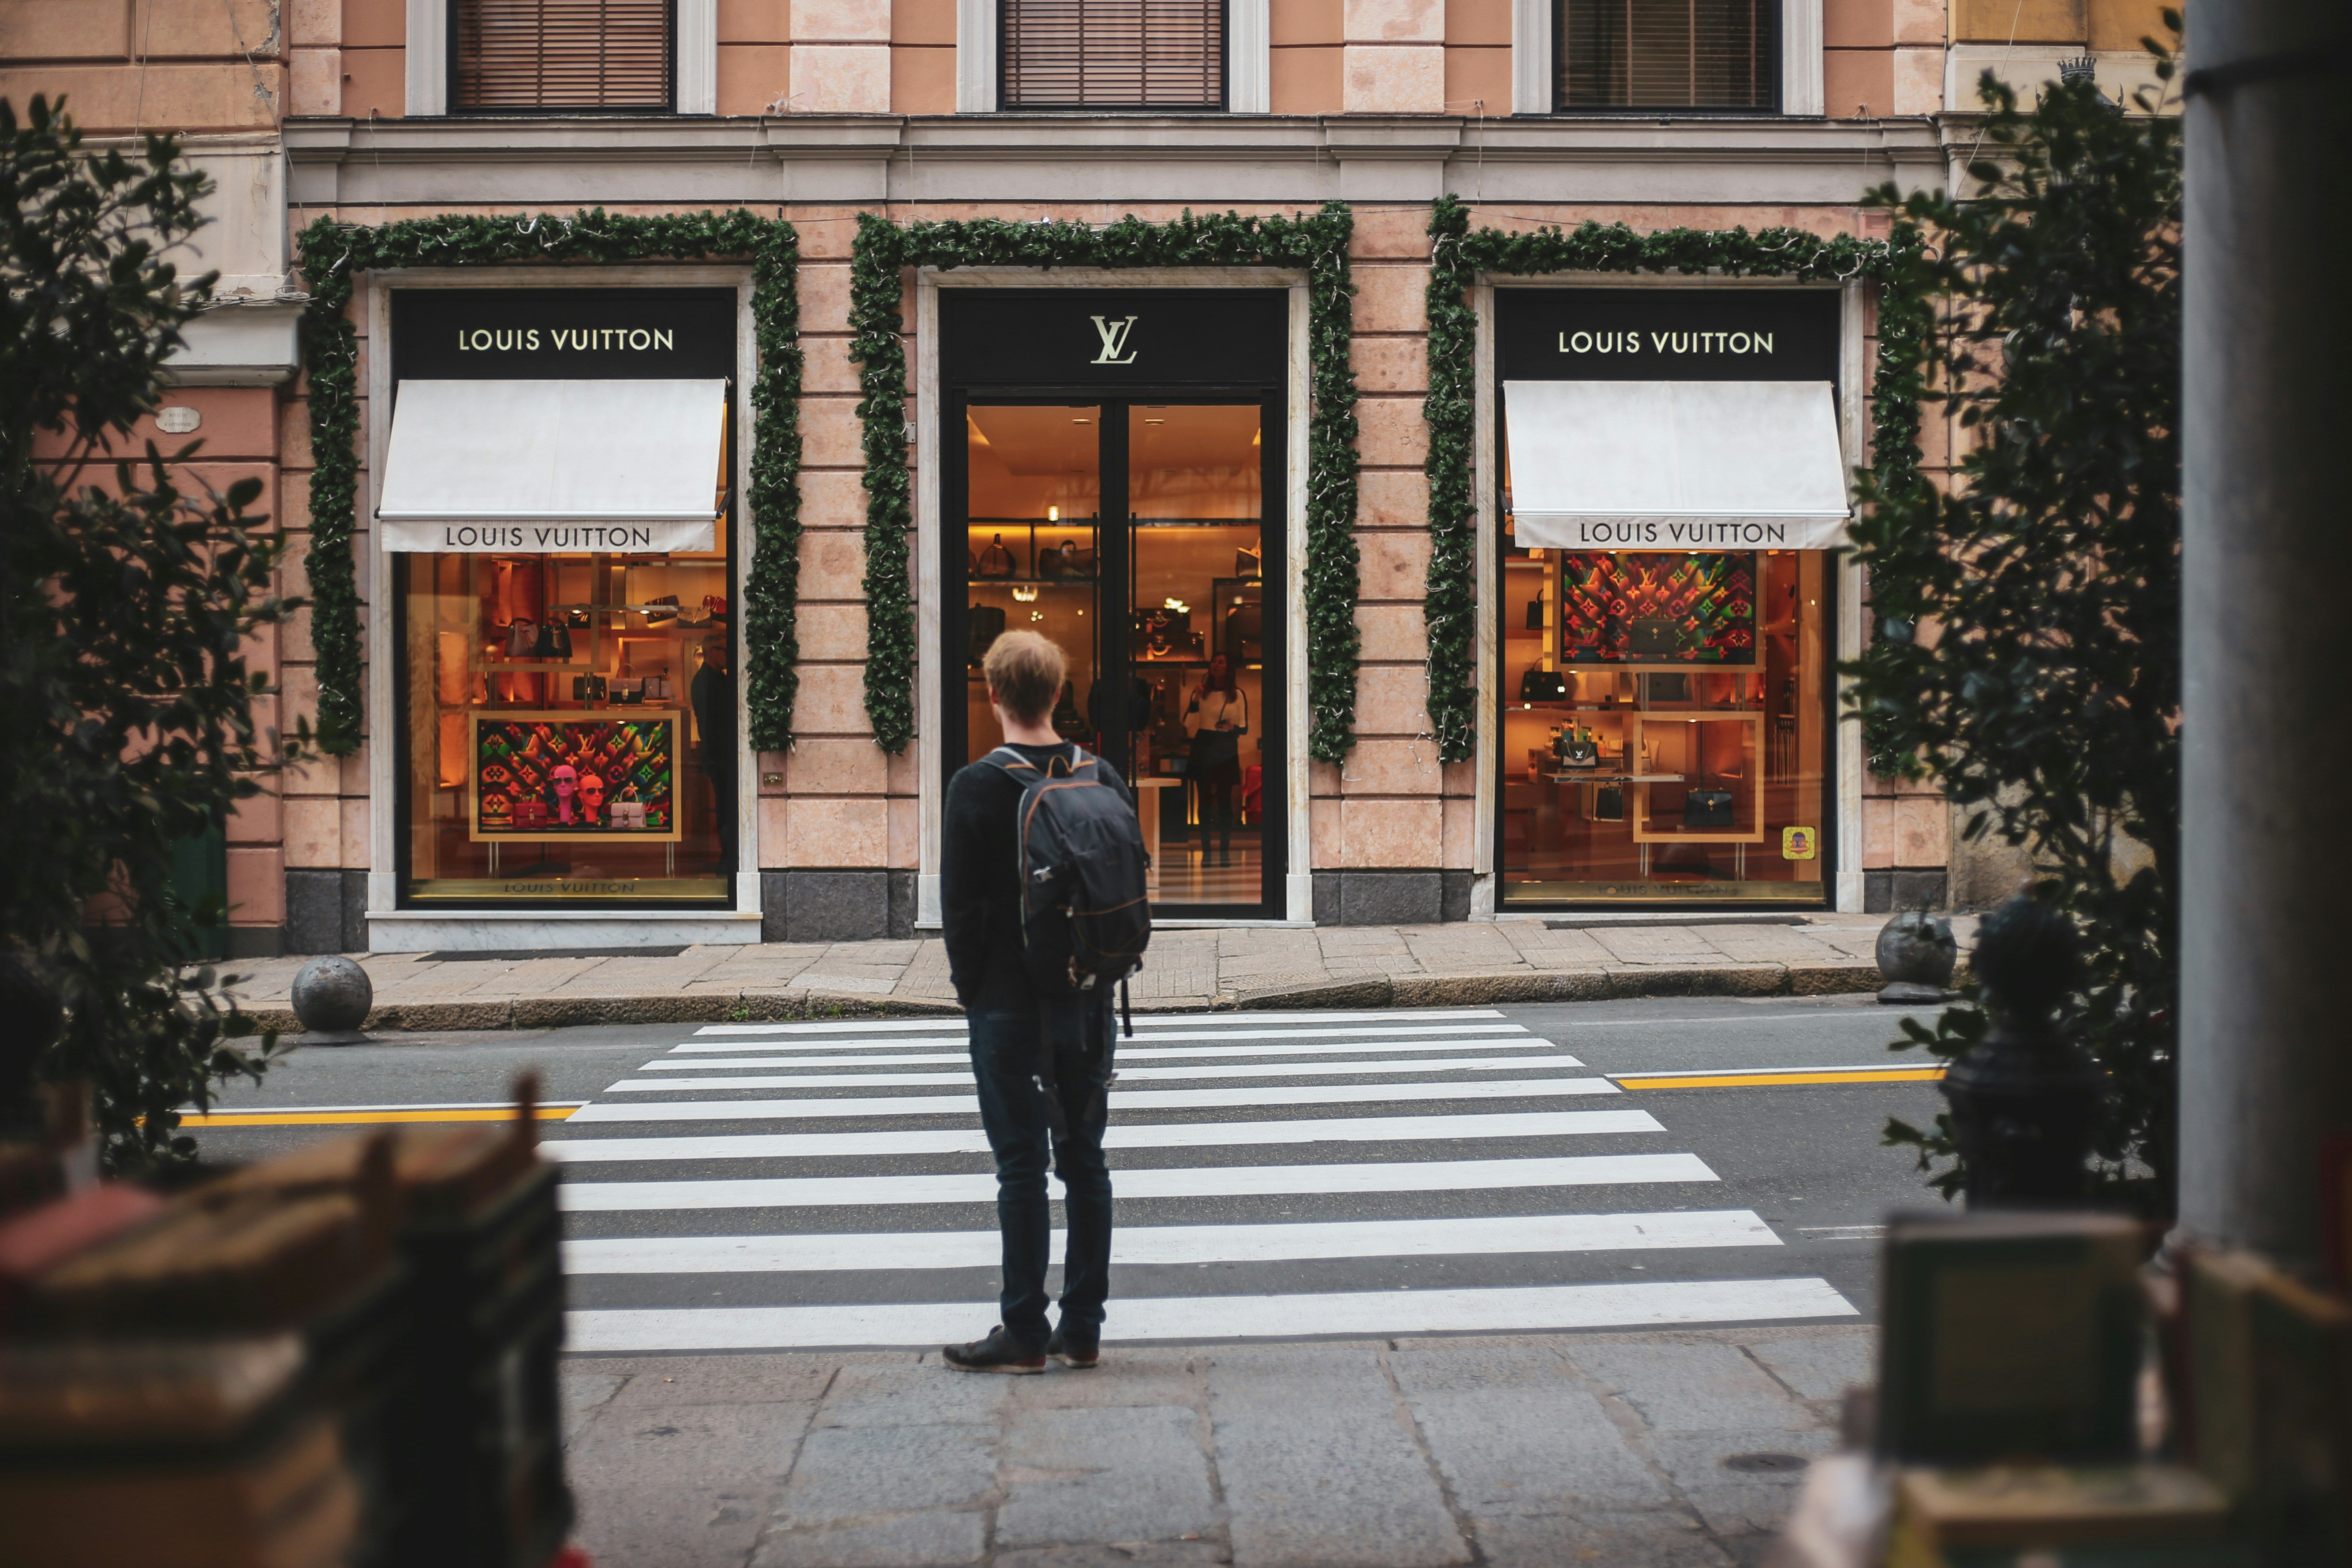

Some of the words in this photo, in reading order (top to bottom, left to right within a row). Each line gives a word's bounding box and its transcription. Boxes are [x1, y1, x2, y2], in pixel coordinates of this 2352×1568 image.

[459, 329, 540, 351] LOUIS
[551, 329, 673, 351] VUITTON
[1559, 332, 1640, 354] LOUIS
[1651, 332, 1773, 354] VUITTON
[446, 526, 523, 547] LOUIS
[534, 527, 650, 547] VUITTON
[1580, 523, 1658, 543] LOUIS
[1669, 523, 1785, 543] VUITTON
[504, 883, 553, 892] LOUIS
[561, 883, 635, 892] VUITTON
